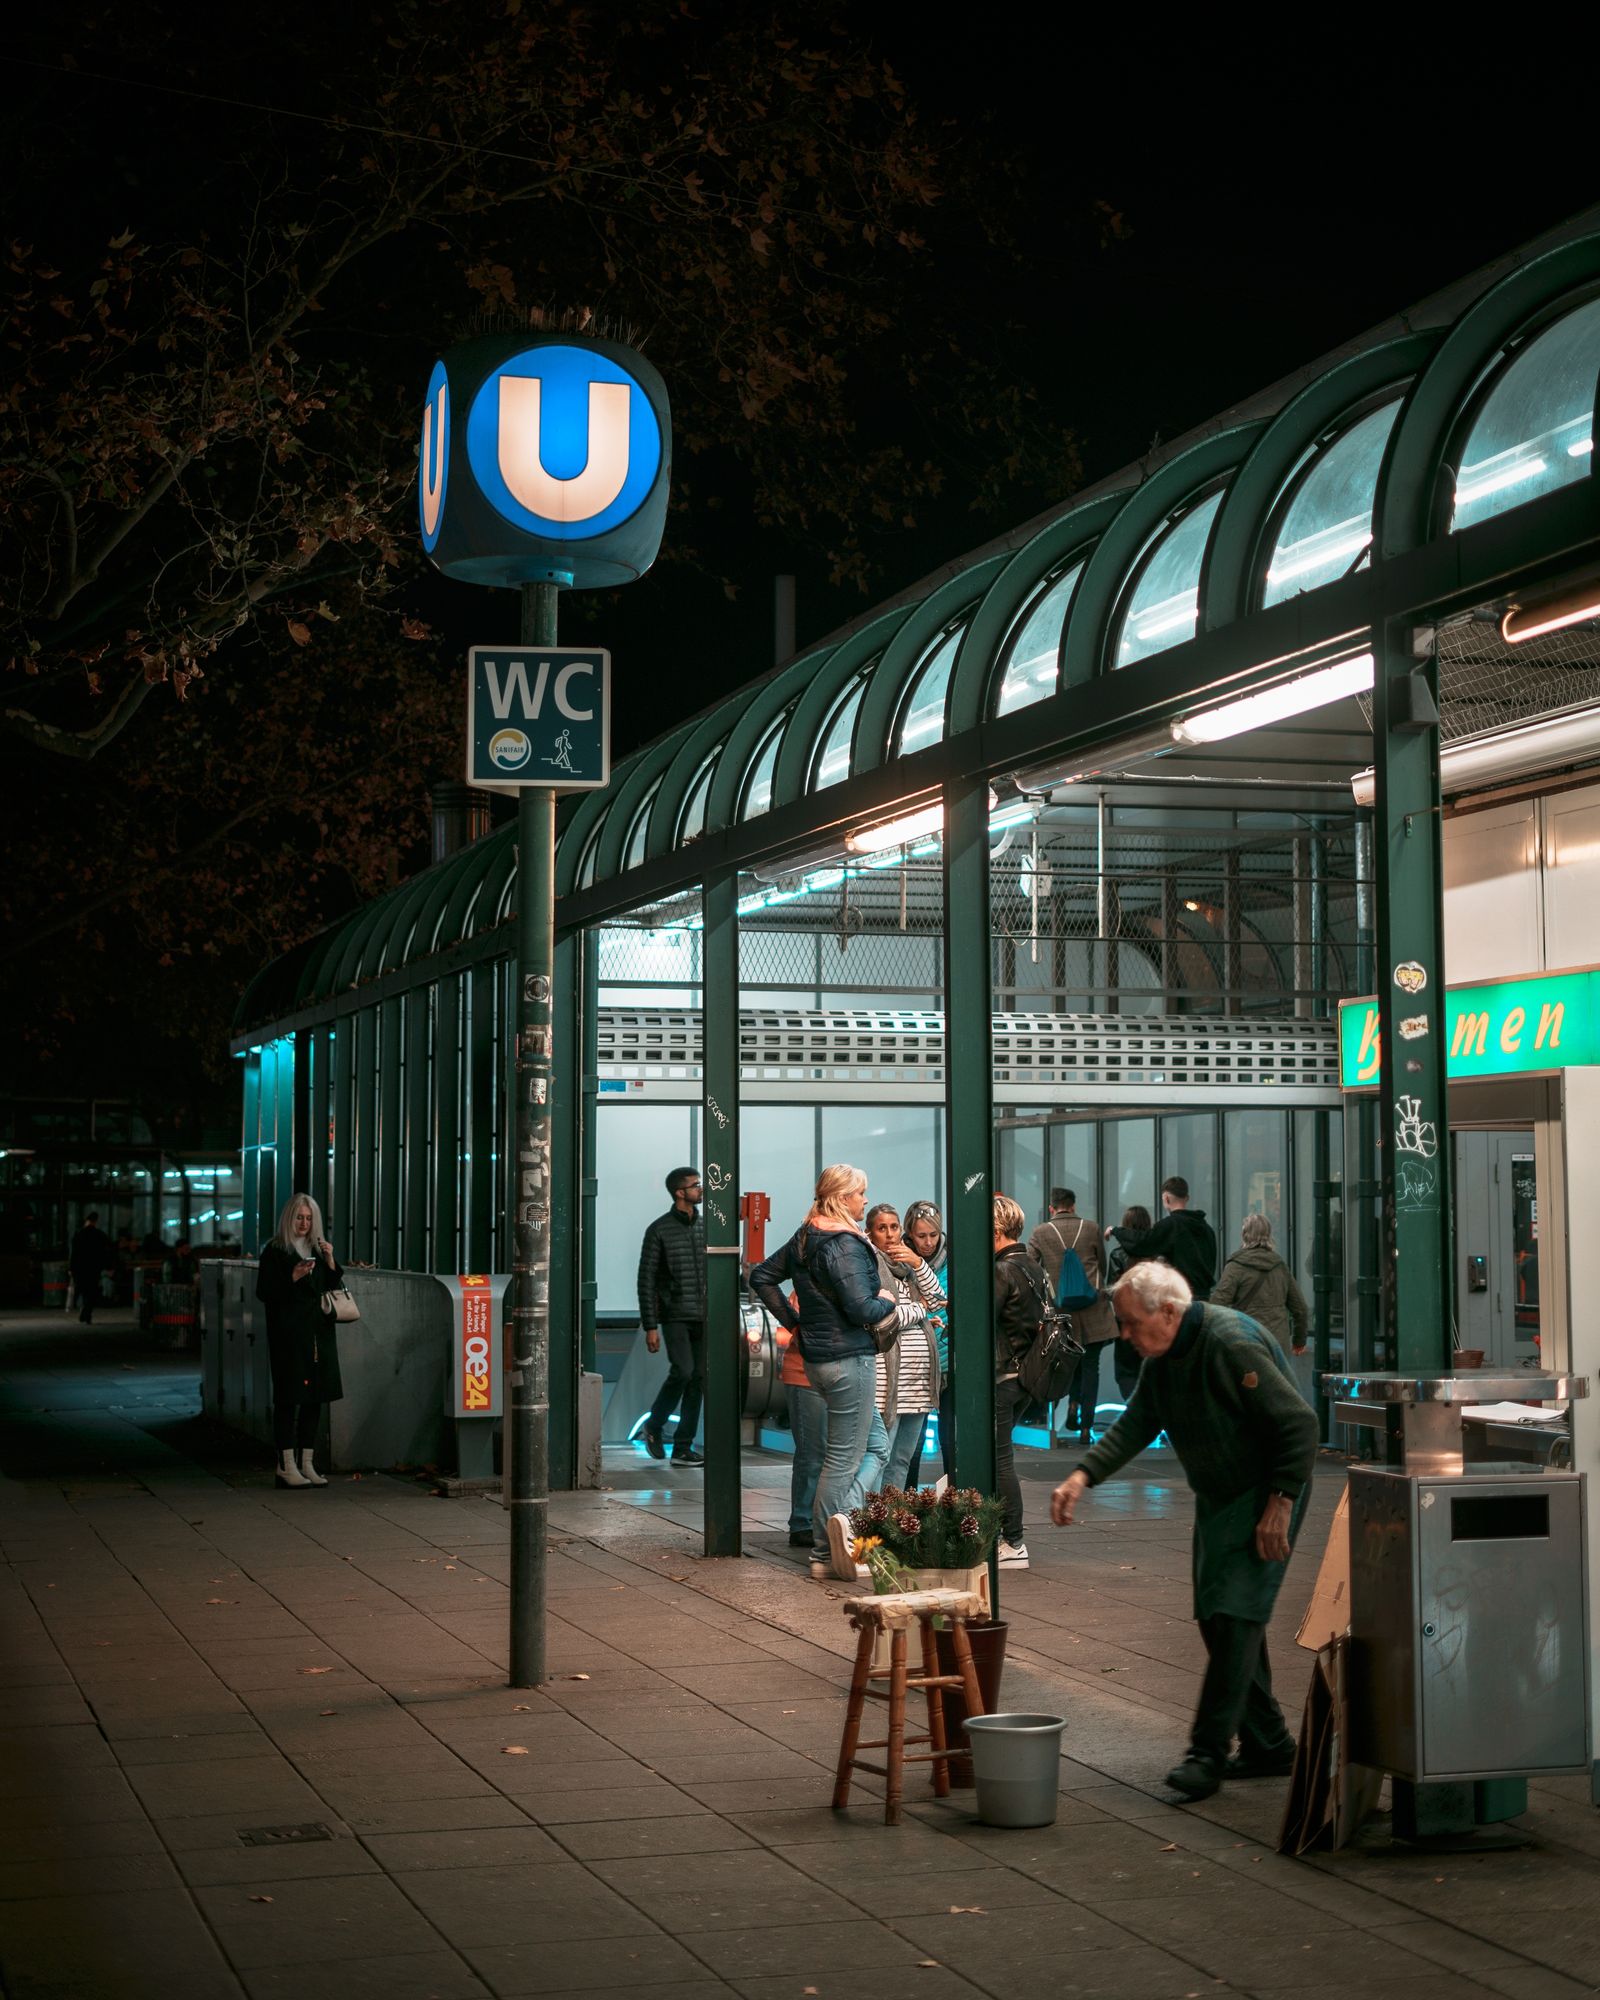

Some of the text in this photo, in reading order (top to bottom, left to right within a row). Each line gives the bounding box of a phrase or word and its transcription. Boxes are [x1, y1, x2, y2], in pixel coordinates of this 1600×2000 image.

[423, 383, 446, 536] U
[498, 375, 631, 523] U
[484, 661, 594, 721] WC
[465, 1336, 488, 1409] oe24
